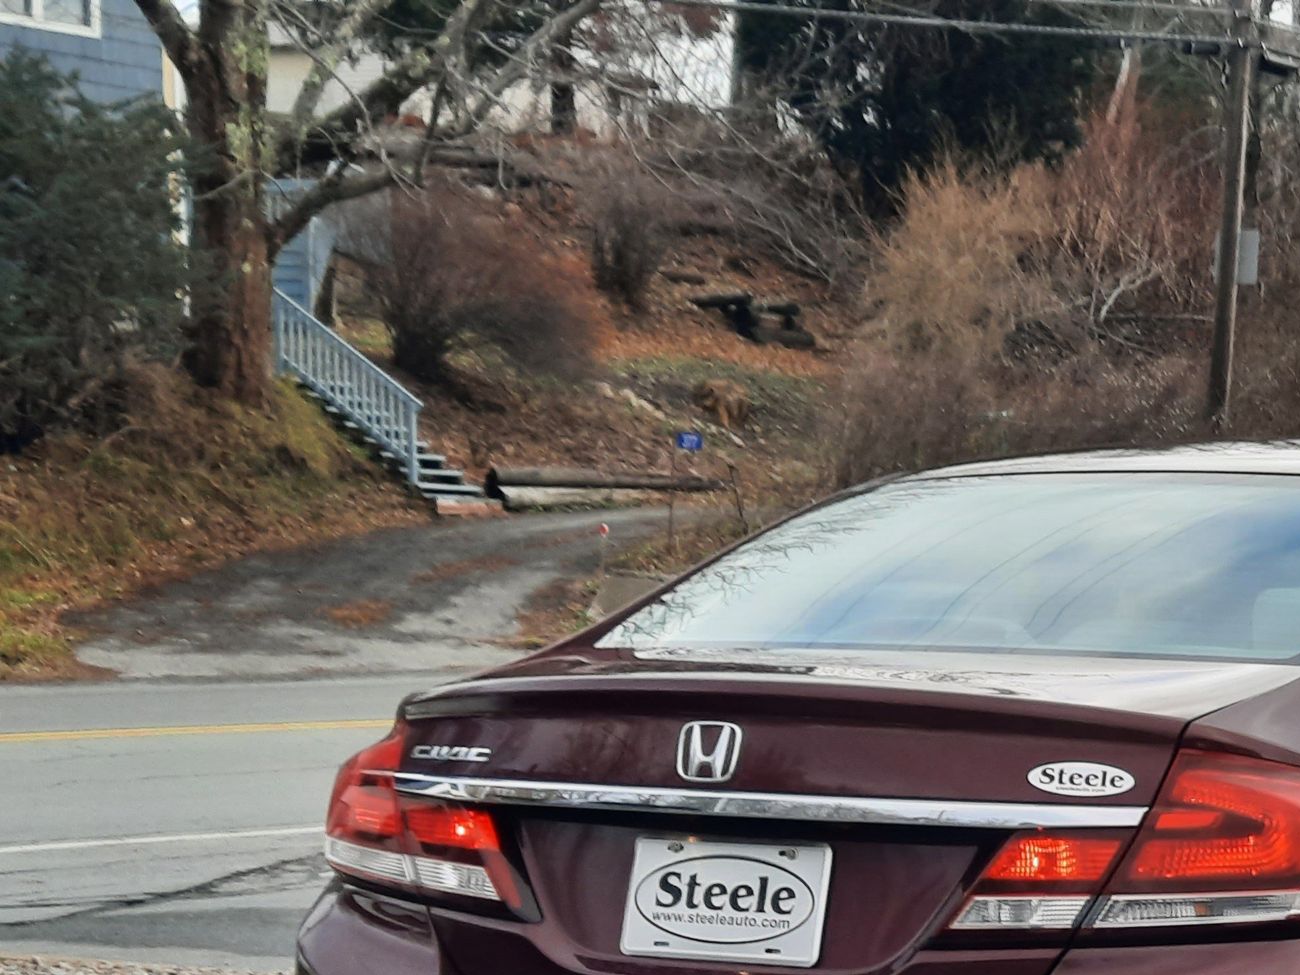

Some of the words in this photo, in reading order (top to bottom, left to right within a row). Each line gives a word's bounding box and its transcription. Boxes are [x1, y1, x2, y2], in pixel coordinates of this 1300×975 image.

[410, 745, 491, 762] CIVIC
[1039, 767, 1125, 788] Steele
[655, 871, 796, 915] Steele
[652, 911, 791, 930] www.steeleauto.com
